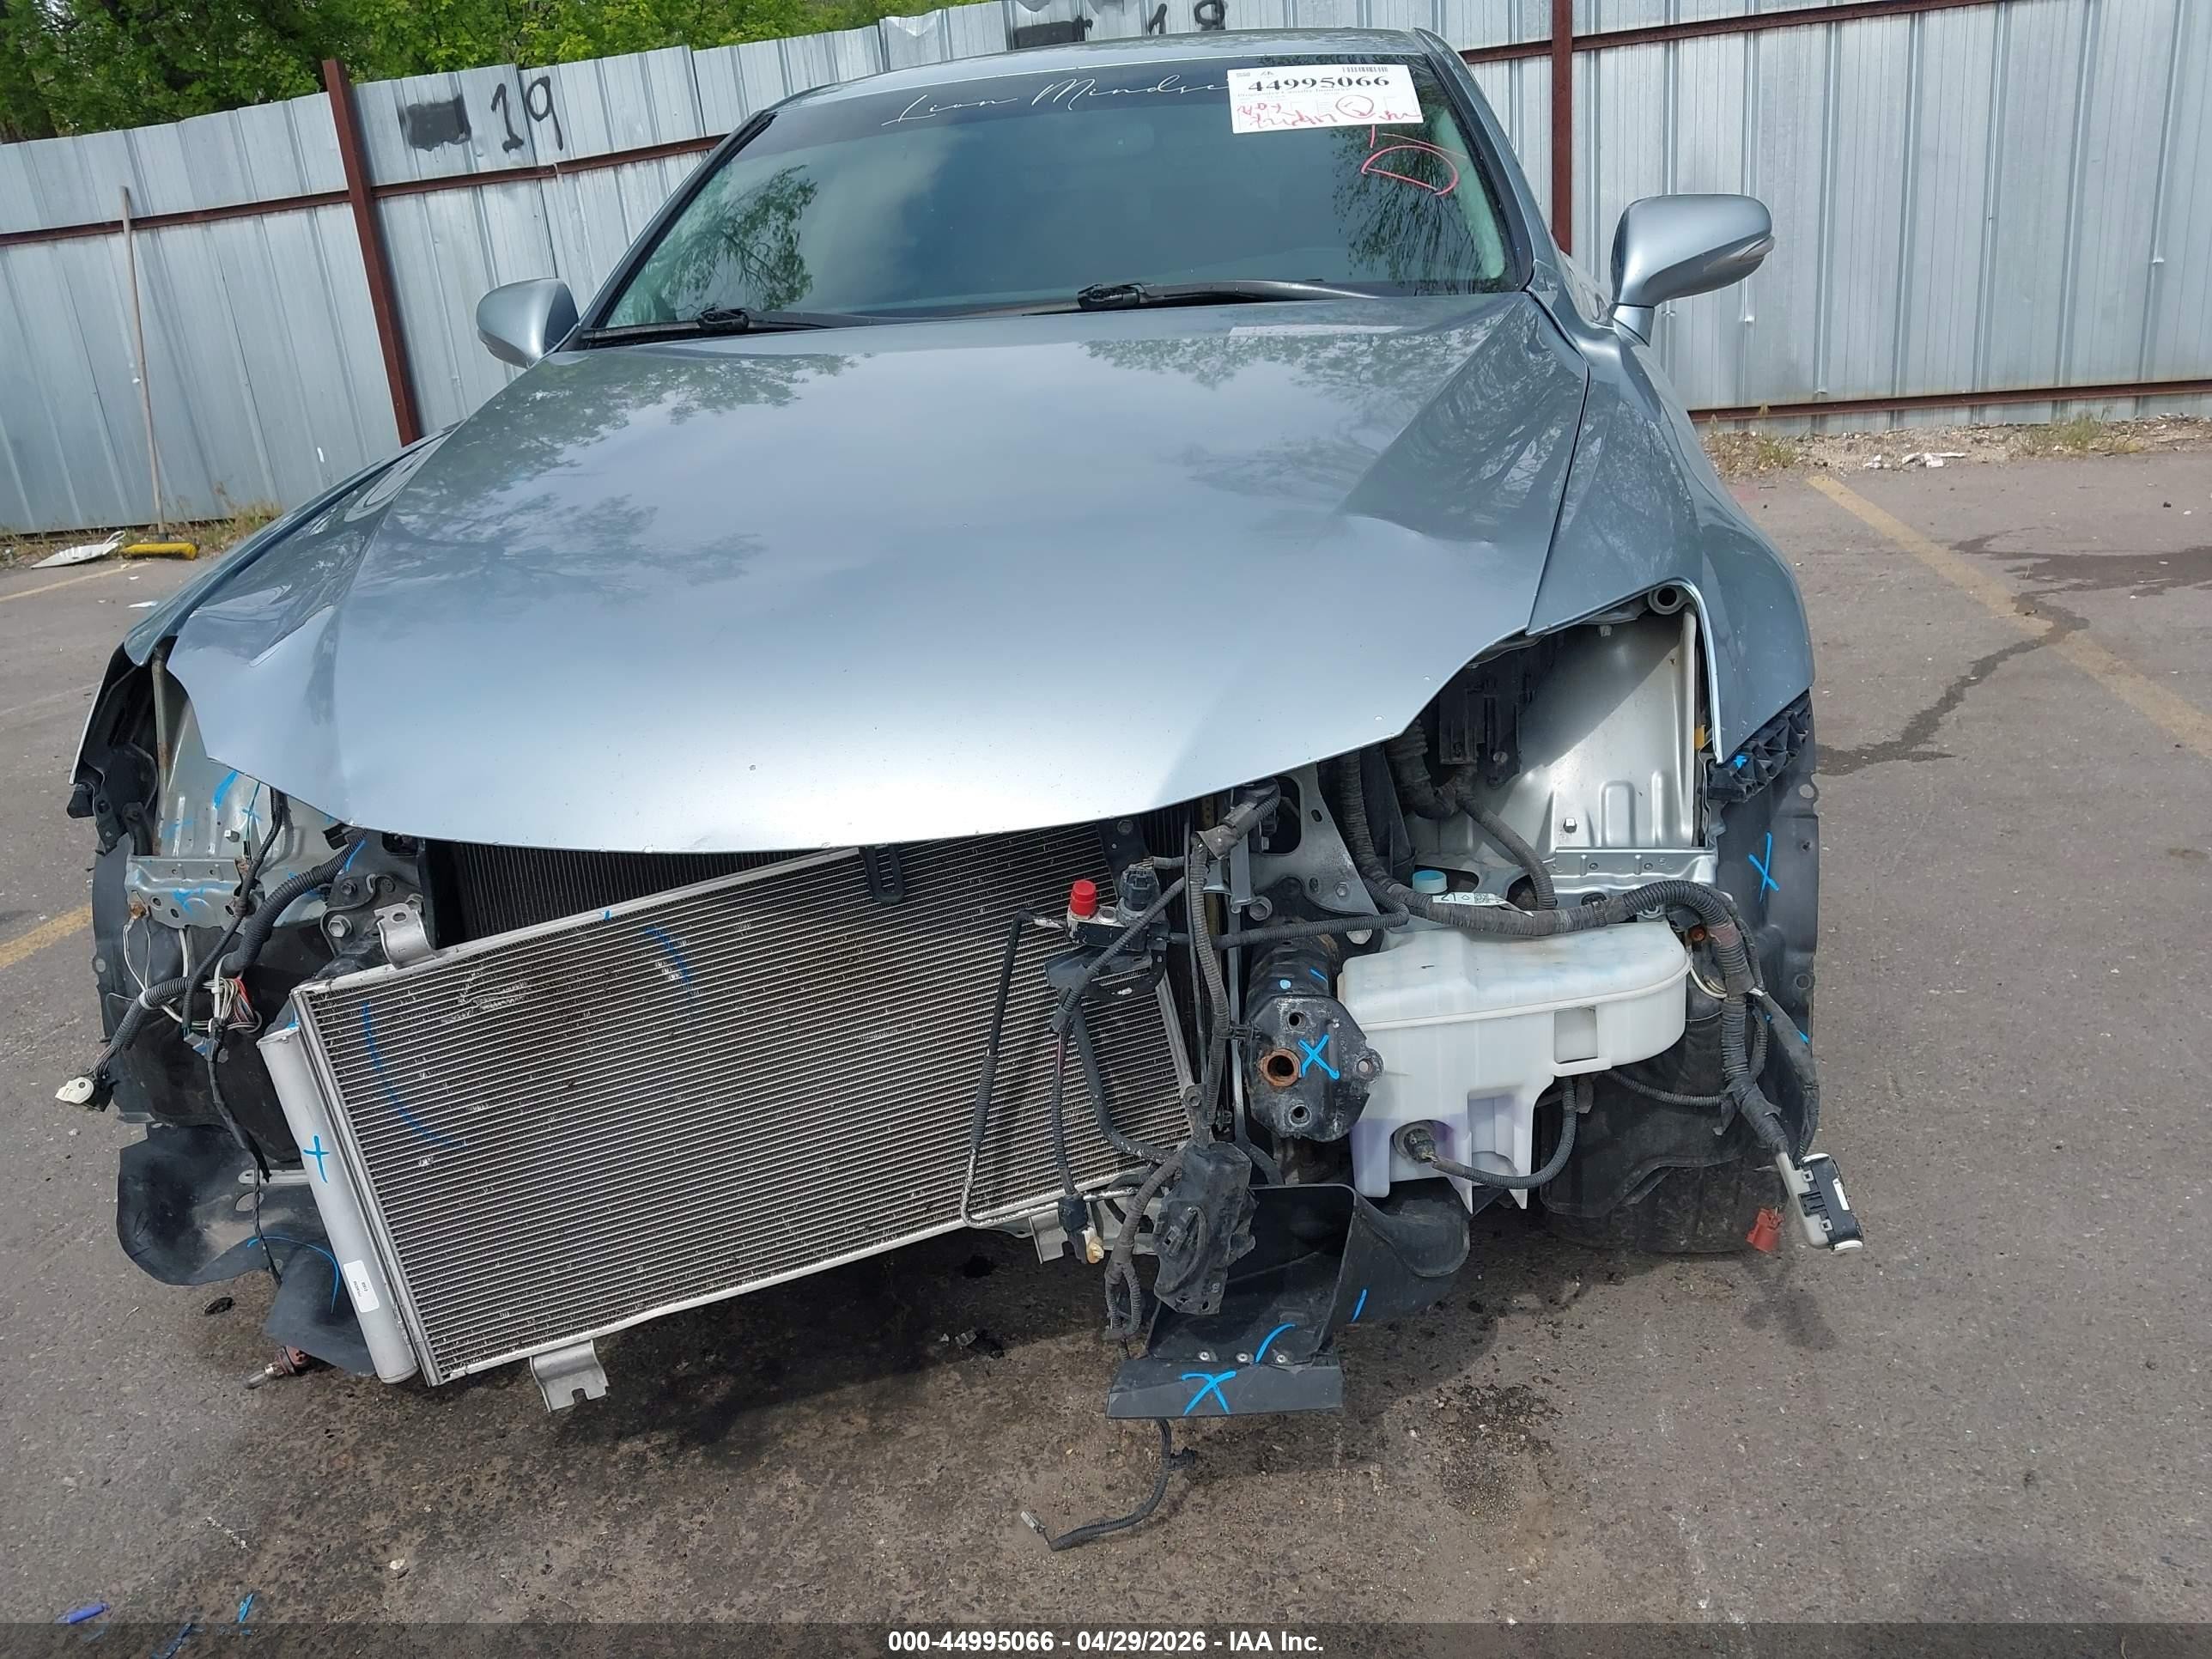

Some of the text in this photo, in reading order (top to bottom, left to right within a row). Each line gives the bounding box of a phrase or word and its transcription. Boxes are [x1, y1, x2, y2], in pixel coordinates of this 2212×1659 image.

[881, 75, 1228, 126] Lion Mindse
[1248, 76, 1390, 92] 44995066
[490, 76, 563, 153] 19
